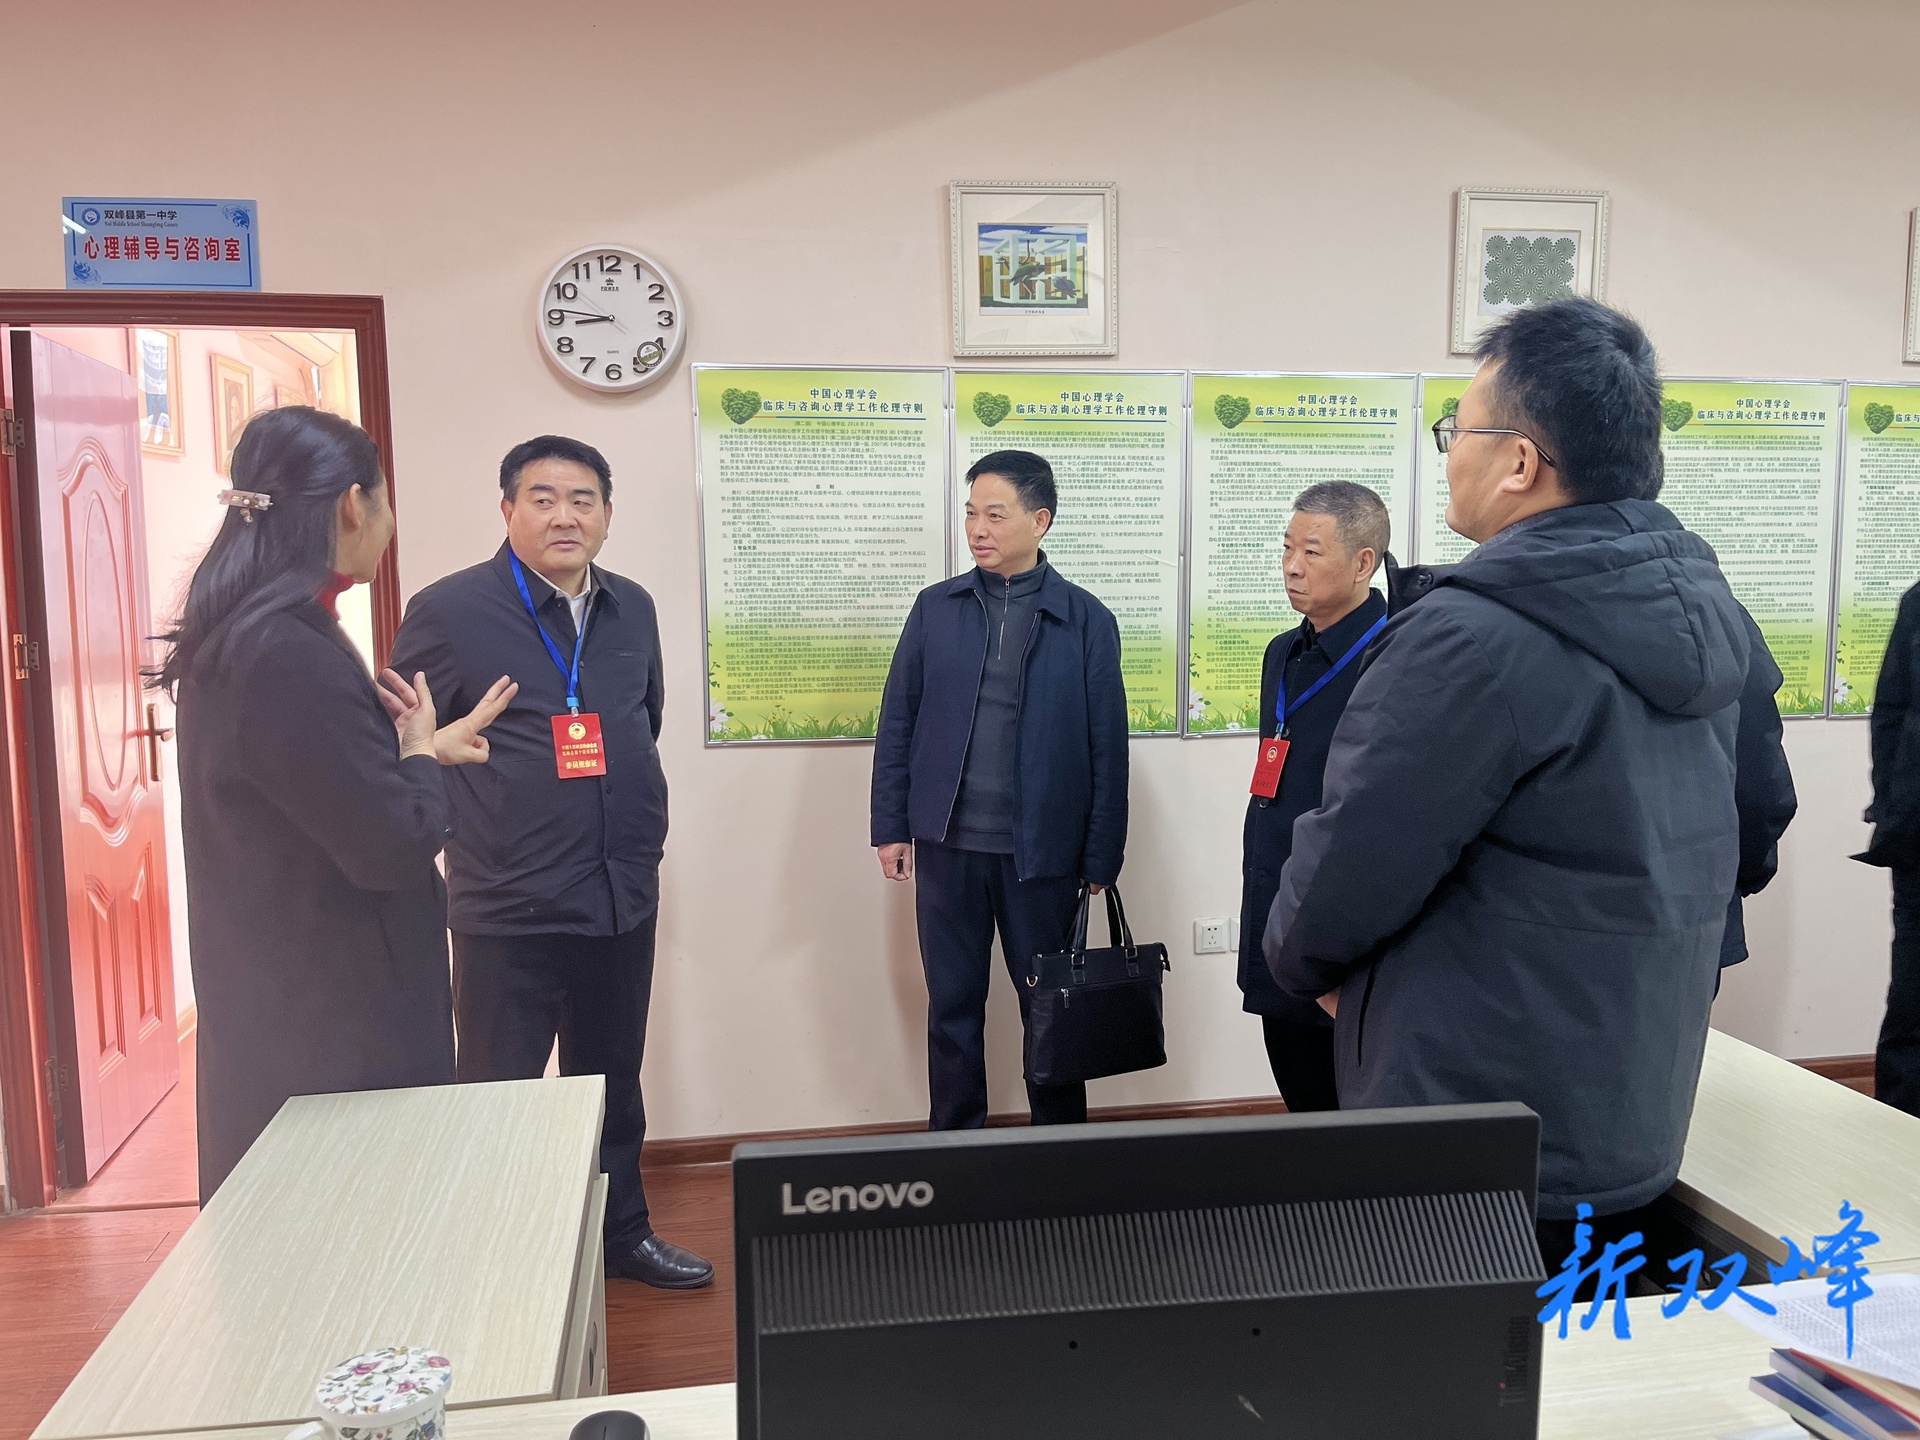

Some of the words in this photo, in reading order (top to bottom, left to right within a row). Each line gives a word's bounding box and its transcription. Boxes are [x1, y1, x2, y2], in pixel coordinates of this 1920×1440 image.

[104, 209, 178, 220] 双峰县第一中学
[84, 236, 241, 262] 心理辅导与咨询室
[572, 262, 590, 280] 11
[597, 254, 622, 273] 12
[633, 263, 641, 280] 1
[554, 282, 578, 300] 10
[648, 283, 665, 301] 2
[547, 308, 565, 326] 9
[657, 310, 674, 327] 3
[557, 336, 574, 354] 8
[579, 356, 596, 374] 7
[605, 363, 623, 381] 6
[810, 388, 878, 400] 中国心理学会
[1060, 391, 1125, 402] 中国心理学会
[1297, 394, 1358, 405] 中国心理学会
[763, 401, 923, 413] 临床与咨询心理学工作伦理守则
[1016, 404, 1168, 416] 临床与咨询心理学工作伦理守则
[1255, 406, 1398, 419] 临床与咨询心理学工作伦理守则
[1736, 399, 1791, 409] 中国心理学会
[1697, 410, 1826, 421] 临床与咨询心理学工作伦理守则
[782, 1181, 934, 1216] Lenovo
